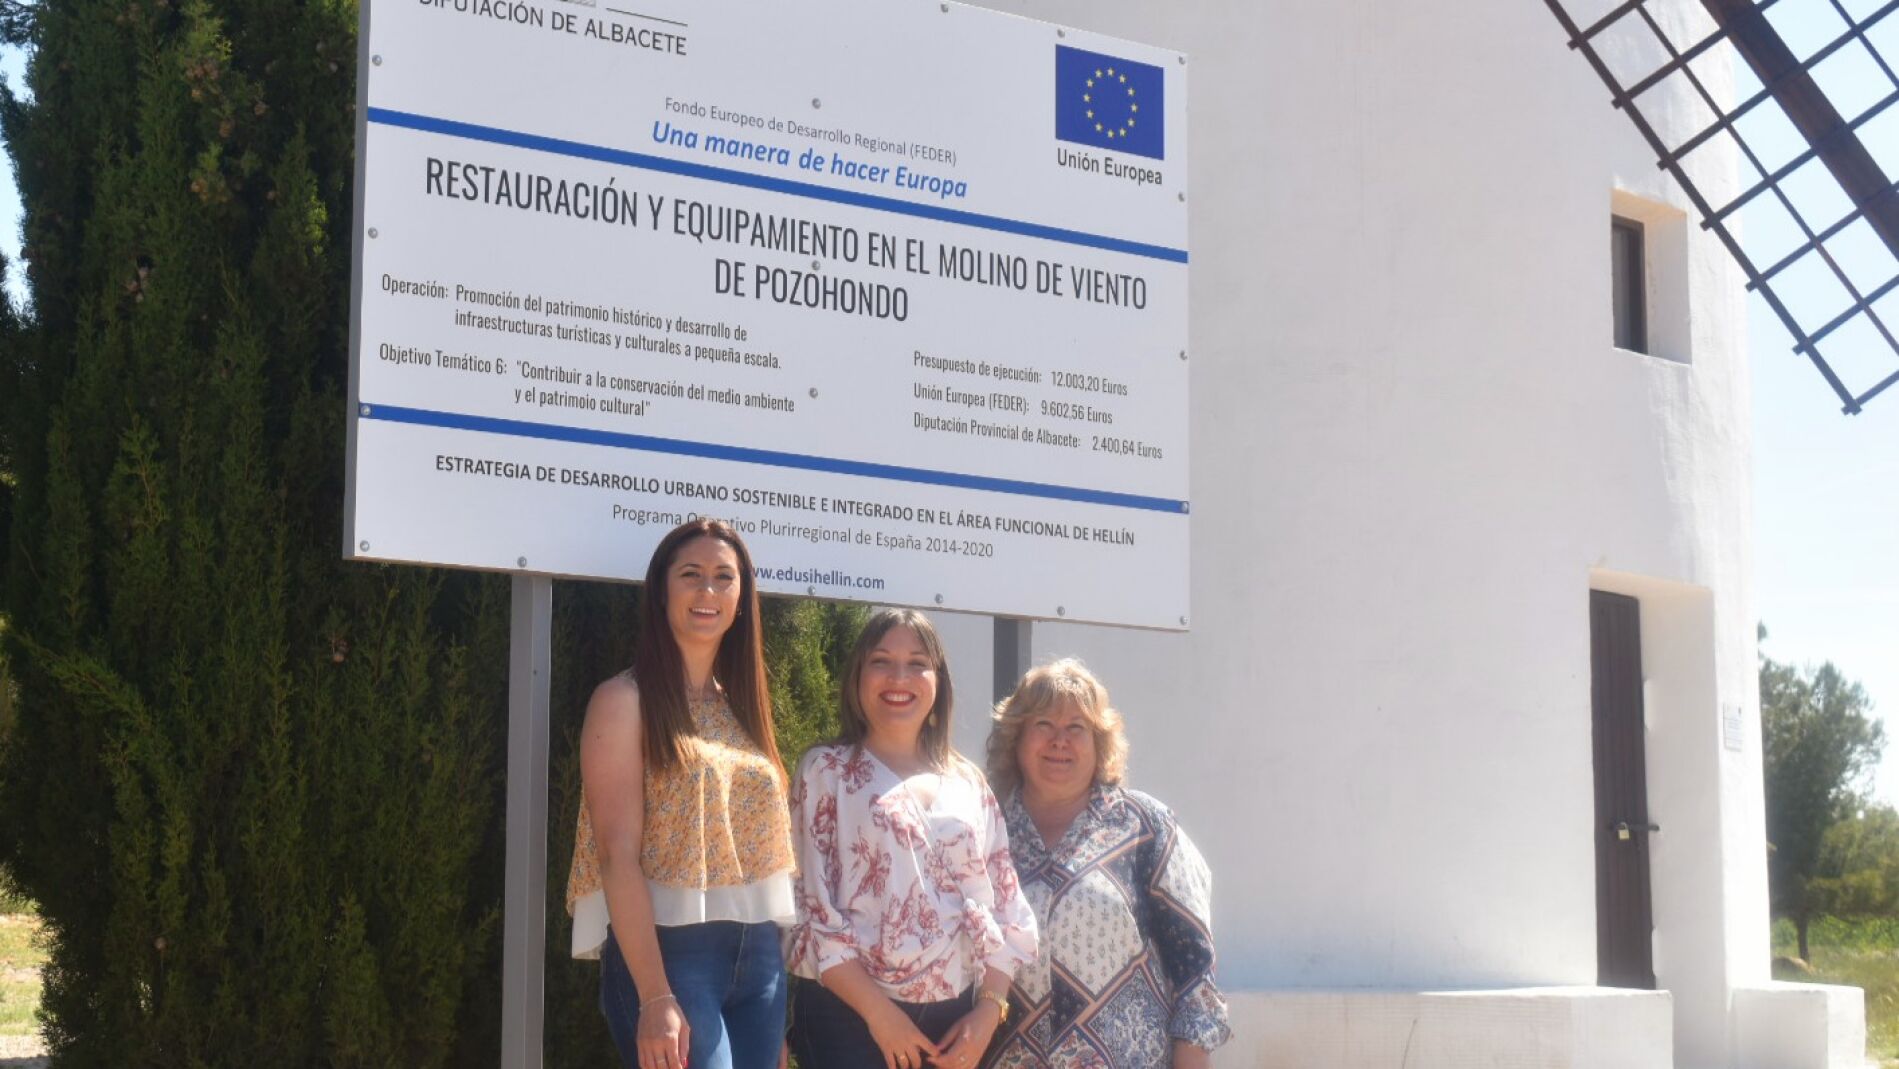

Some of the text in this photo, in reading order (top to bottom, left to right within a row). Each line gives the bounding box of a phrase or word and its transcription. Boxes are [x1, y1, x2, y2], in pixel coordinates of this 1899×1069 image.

[420, 0, 686, 56] UTACIÓN DE ALBACETE
[652, 121, 967, 198] Una manera de hacer Europa
[666, 97, 956, 167] Fondo Europeo de Desarrollo Regional (FEDER)
[1058, 147, 1162, 186] Unión Europea
[427, 157, 1146, 309] RESTAURACIÓN Y EQUIPAMIENTO EN EL MOLINO DE VIENTO
[382, 274, 747, 342] Operación: Promoción del patrimonio histórico y desarrollo de
[716, 258, 908, 321] DE POZOHONDO
[455, 309, 781, 369] infraestructuras turísticas y culturales a pequeña escala.
[380, 343, 794, 412] Objetivo Temático 6: "Contribuir a la conservación del medio ambiente
[514, 386, 650, 416] y el patrimoio cultural"
[914, 350, 1127, 396] Presupuesto de ejecución: 12.003,20 Euros
[914, 382, 1112, 424] Unión Europea (FEDER): 9.602,56 Euros
[914, 412, 1163, 459] Diputación Provincial de Albacete: 2.400,64 Euros
[436, 455, 1134, 545] ESTRATEGIA DE DESARROLLO URBANO SOSTENIBLE E INTEGRADO EN EL ÁREA FUNCIONAL DE HELLÍN
[613, 504, 682, 526] Programa
[761, 520, 850, 543] Plurirregional
[855, 529, 872, 544] de
[877, 532, 921, 550] España
[926, 537, 993, 558] 2014-2020
